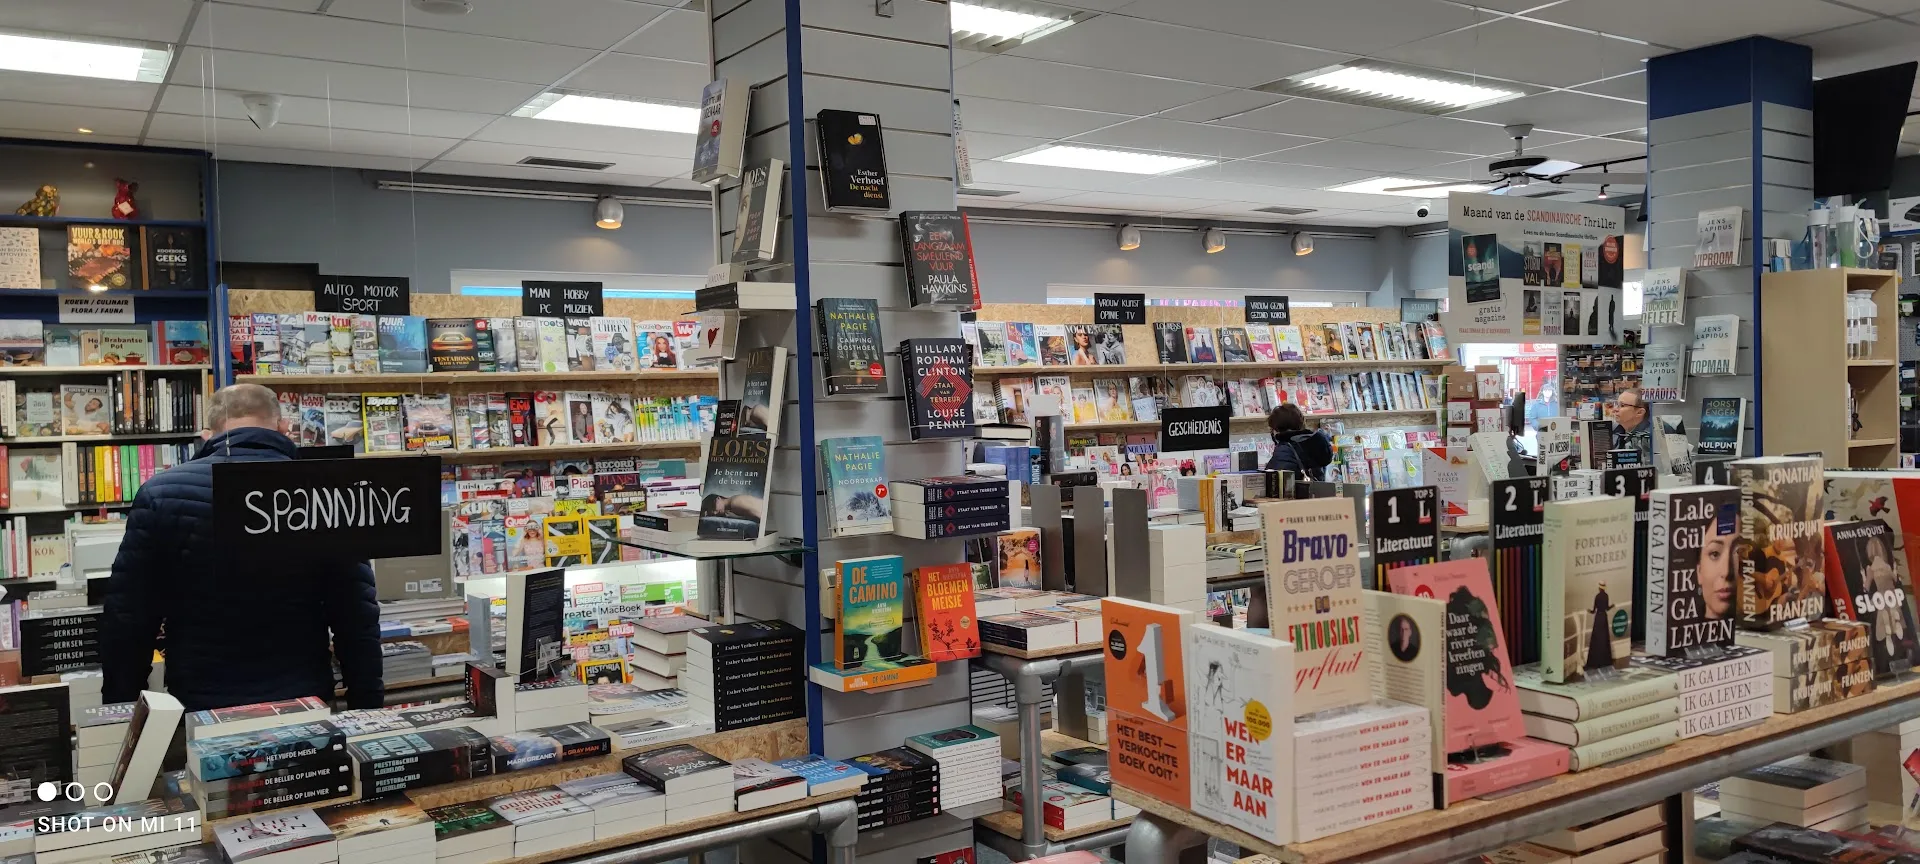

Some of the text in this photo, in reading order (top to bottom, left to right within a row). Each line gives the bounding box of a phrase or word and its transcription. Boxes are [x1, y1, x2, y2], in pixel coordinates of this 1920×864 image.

[850, 175, 885, 185] Verhoef
[863, 191, 883, 199] dienst
[1463, 206, 1617, 229] Maand van de SCANDINAVISCHE Thriller
[1700, 224, 1732, 232] LAPIDUS
[929, 231, 947, 240] EEN
[913, 241, 965, 251] LANGZAAM
[156, 255, 187, 263] GEEKS
[917, 252, 964, 261] SMEULEND
[930, 261, 954, 271] VUUR
[1468, 259, 1494, 272] scandi
[928, 274, 959, 284] PAULA
[1524, 273, 1540, 284] VAL
[324, 284, 399, 298] AUTO MOTOR
[529, 288, 590, 300] MAN HOBBY
[921, 284, 967, 294] HAWKINS
[342, 298, 382, 311] SPORT
[539, 304, 594, 314] PC MUZIEK
[1099, 299, 1119, 308] VROUW
[1250, 302, 1285, 310] VROUW GEZIN
[1479, 305, 1501, 315] gratis
[830, 312, 876, 322] NATHALIE
[1100, 311, 1135, 320] OPINIE TV
[1250, 311, 1287, 319] GEZOND KOKEN
[1475, 314, 1505, 324] magazine
[539, 320, 564, 328] roots
[840, 322, 868, 331] PAGIE
[837, 344, 876, 352] OOSTHOEK
[915, 345, 963, 354] HILLARY
[917, 356, 964, 365] RODHAM
[1691, 359, 1730, 374] TOPMAN
[918, 366, 966, 376] CLINTON
[1641, 388, 1677, 400] PARADIJS
[927, 408, 965, 419] LOUISE
[1705, 408, 1736, 416] ENGER
[929, 420, 966, 430] PENNY
[712, 438, 769, 458] LOES
[1698, 441, 1737, 449] NULPUNT
[834, 452, 880, 462] NATHALIE
[595, 460, 635, 469] RECORD
[845, 462, 873, 472] PAGIE
[714, 468, 723, 477] Je
[725, 469, 741, 477] bent
[1704, 466, 1714, 485] 4
[1767, 464, 1823, 486] JONATHAN
[719, 477, 751, 486] de beurt
[838, 476, 884, 485] NOORDKAAP
[1615, 475, 1625, 498] 3
[1637, 470, 1648, 478] TOP
[956, 488, 970, 496] STAAT
[1505, 479, 1546, 511] 2 TOP 5
[1387, 489, 1434, 524] 1 TOP 5
[1673, 497, 1714, 522] Lale
[1769, 519, 1823, 542] KRUISPUNT
[1836, 525, 1886, 540] ANNA ENQUIST
[1376, 534, 1434, 554] Literatuur
[1575, 530, 1628, 550] FORTUNA'S
[1673, 527, 1706, 551] Gül
[1741, 469, 1755, 622] KRUISPUNT FRANZEN
[34, 546, 56, 557] KOK
[1651, 500, 1666, 616] IK GA LEVEN
[1574, 550, 1628, 568] KINDEREN
[852, 566, 868, 585] DE
[928, 572, 940, 582] HET
[1284, 563, 1356, 595] GEROEP
[1672, 568, 1696, 592] IK
[850, 582, 897, 604] CAMINO
[926, 580, 969, 596] BLOEMEN
[932, 595, 963, 611] MEISJE
[1855, 589, 1905, 615] SLOOP
[1671, 597, 1698, 621] GA
[1769, 596, 1823, 622] FRANZEN
[53, 617, 82, 626] DERKSEN
[1449, 612, 1470, 626] Daar
[54, 628, 83, 637] DERKSEN
[1289, 616, 1360, 652] ENTHOUSIAST
[1447, 623, 1477, 638] waar de
[1670, 618, 1734, 649] LEVEN
[1448, 649, 1485, 664] kreeften
[1793, 635, 1870, 667] KRUISPUNT FRANZEN
[1294, 649, 1363, 693] gefluit
[1455, 661, 1484, 677] zingen
[1683, 659, 1752, 689] IK GA LEVEN
[881, 673, 899, 682] CAMINO
[1116, 724, 1163, 746] HET BEST
[266, 747, 317, 762] HET VIJFDE MEISJE
[567, 745, 599, 756] GRAY MAN
[1118, 739, 1179, 768] VERKOCHTE
[1226, 741, 1246, 763] ER
[507, 752, 557, 766] MARK GREANEY
[1119, 753, 1146, 770] BOEK
[265, 776, 273, 785] DE
[274, 774, 294, 784] BELLER
[295, 772, 304, 781] OP
[317, 768, 330, 777] VIER
[1226, 764, 1274, 798] MAAR
[1233, 794, 1267, 819] AAN
